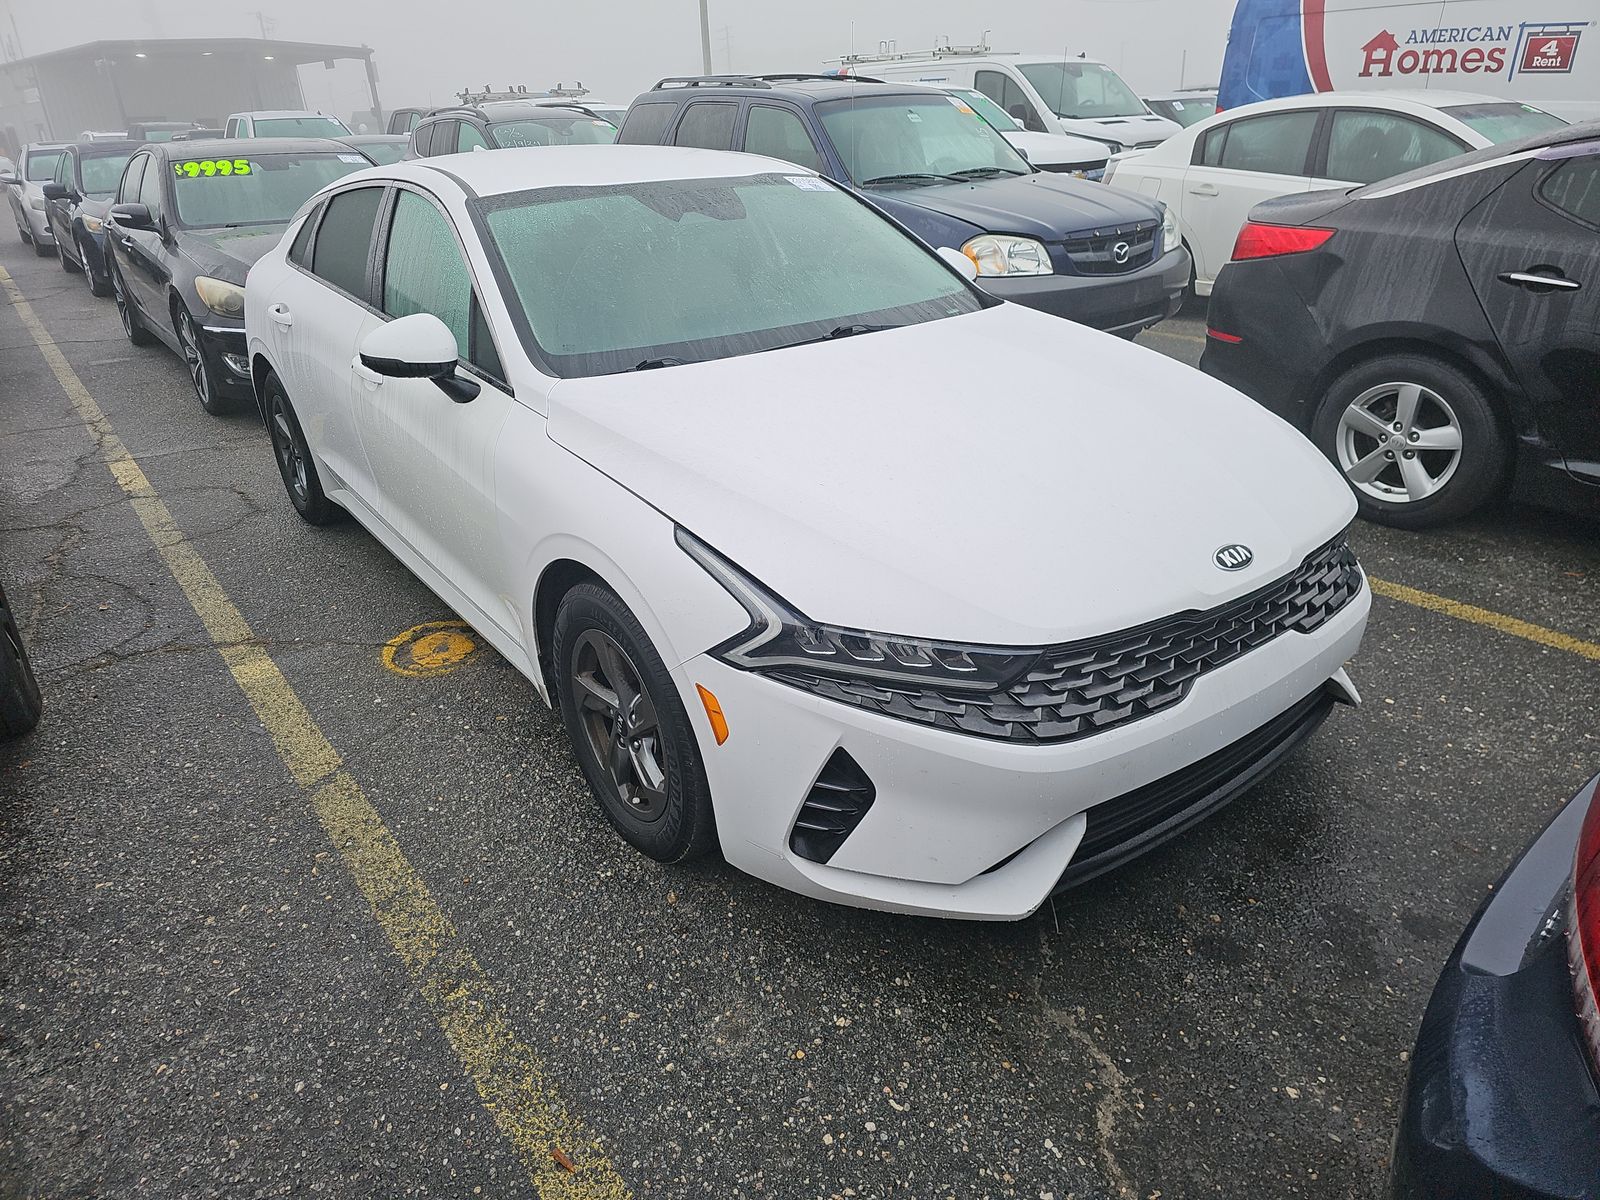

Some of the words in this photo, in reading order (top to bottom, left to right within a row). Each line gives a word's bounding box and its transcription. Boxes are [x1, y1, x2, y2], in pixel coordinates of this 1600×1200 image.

[1404, 26, 1514, 44] AMERICAN
[1358, 30, 1507, 77] Homes
[1540, 40, 1559, 56] 4
[1532, 56, 1562, 67] Rent
[174, 159, 251, 177] $9995
[1217, 545, 1252, 567] KIA
